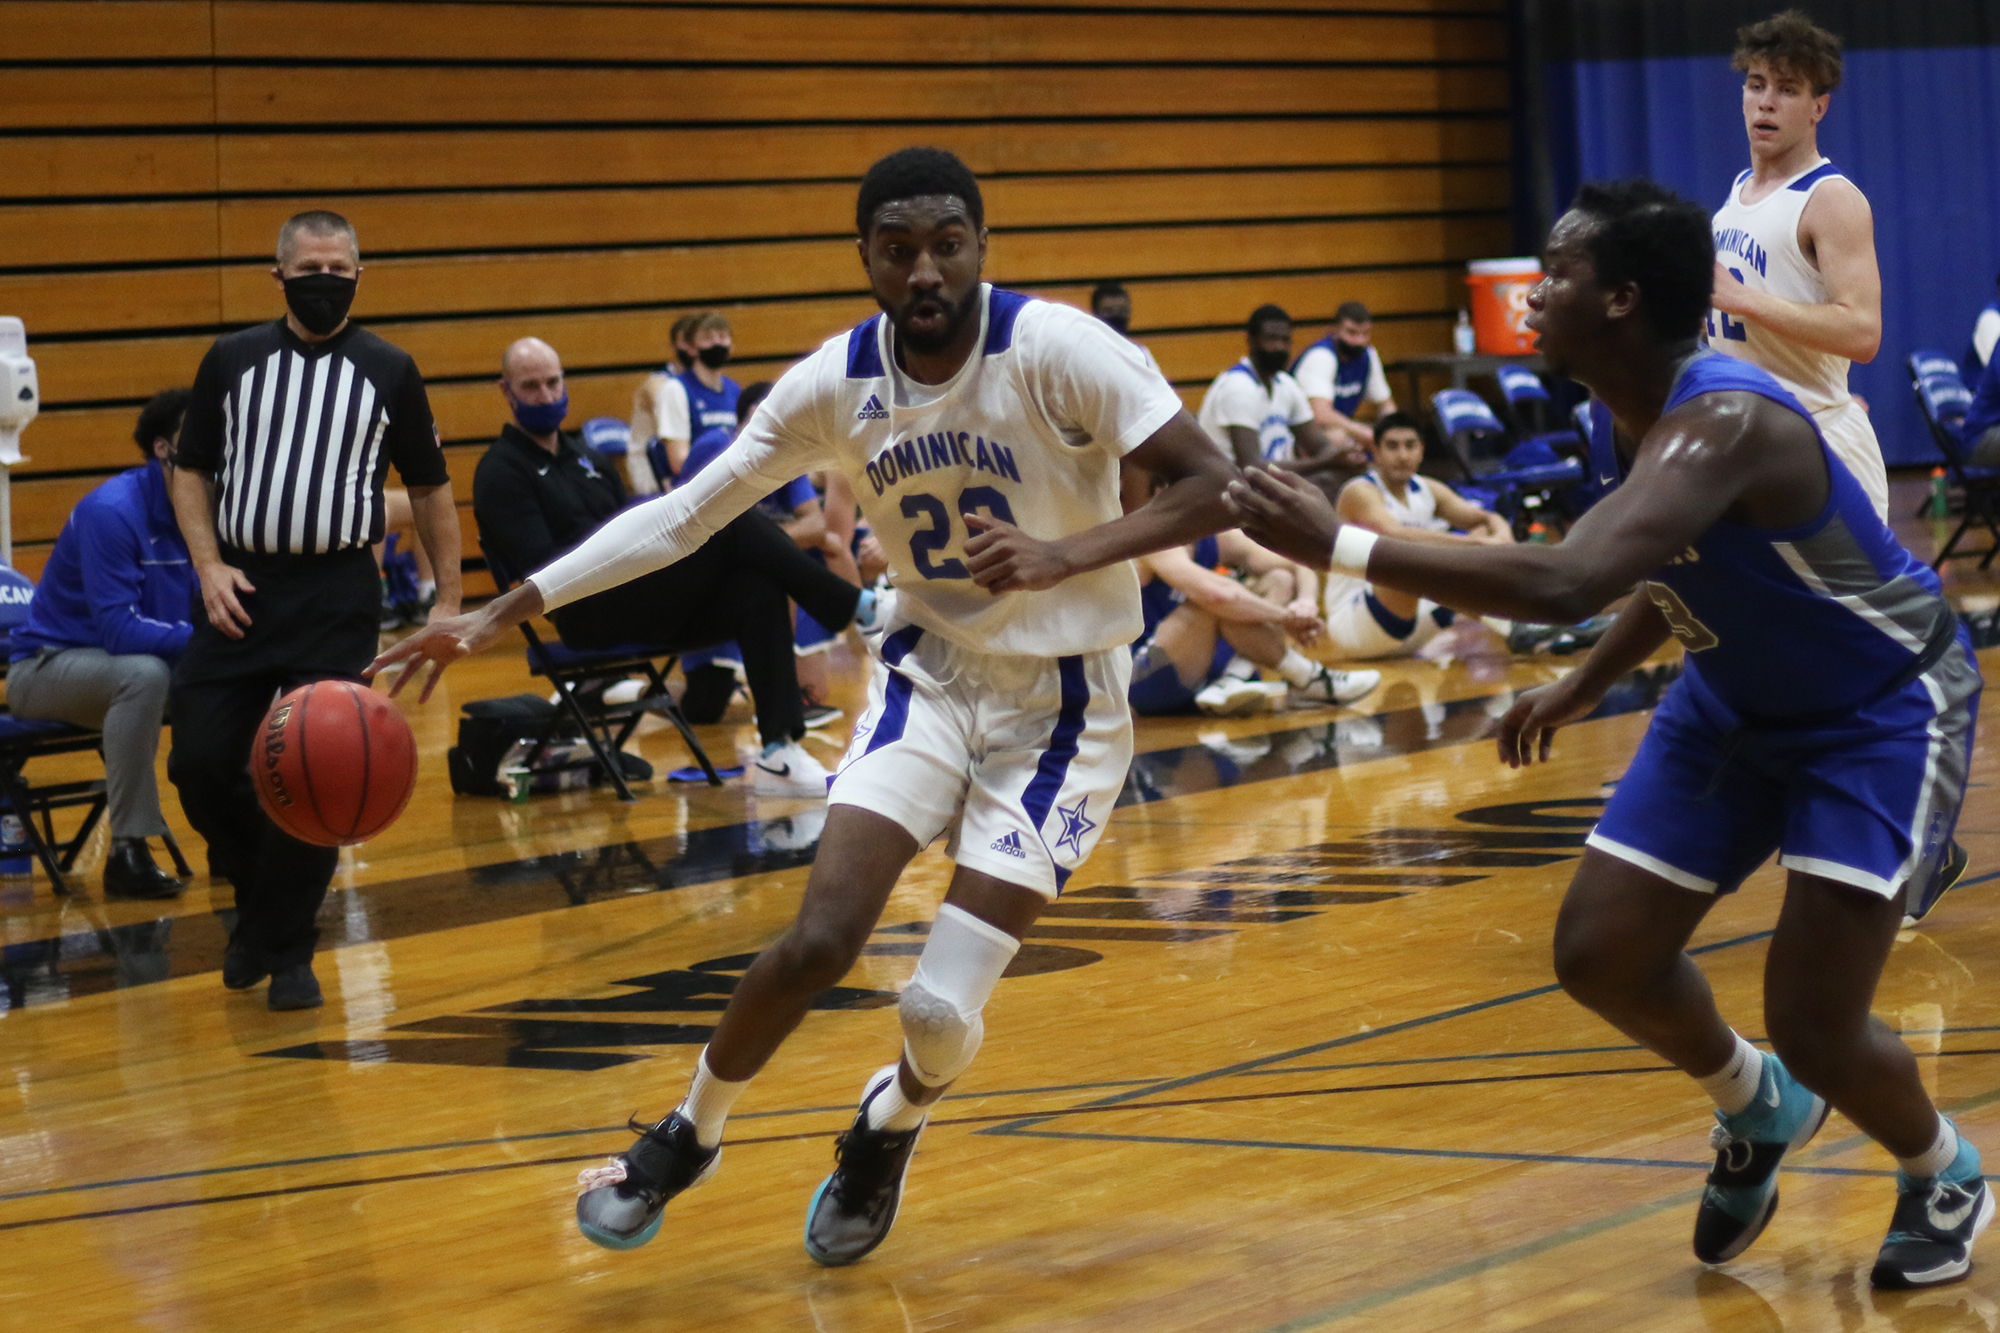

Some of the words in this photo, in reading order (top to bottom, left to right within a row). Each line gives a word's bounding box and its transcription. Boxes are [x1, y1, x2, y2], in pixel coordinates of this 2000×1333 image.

[1713, 228, 1767, 279] OMINICAN
[857, 408, 890, 420] adidas
[865, 431, 1022, 497] DOMINICAN
[990, 841, 1026, 859] adidas
